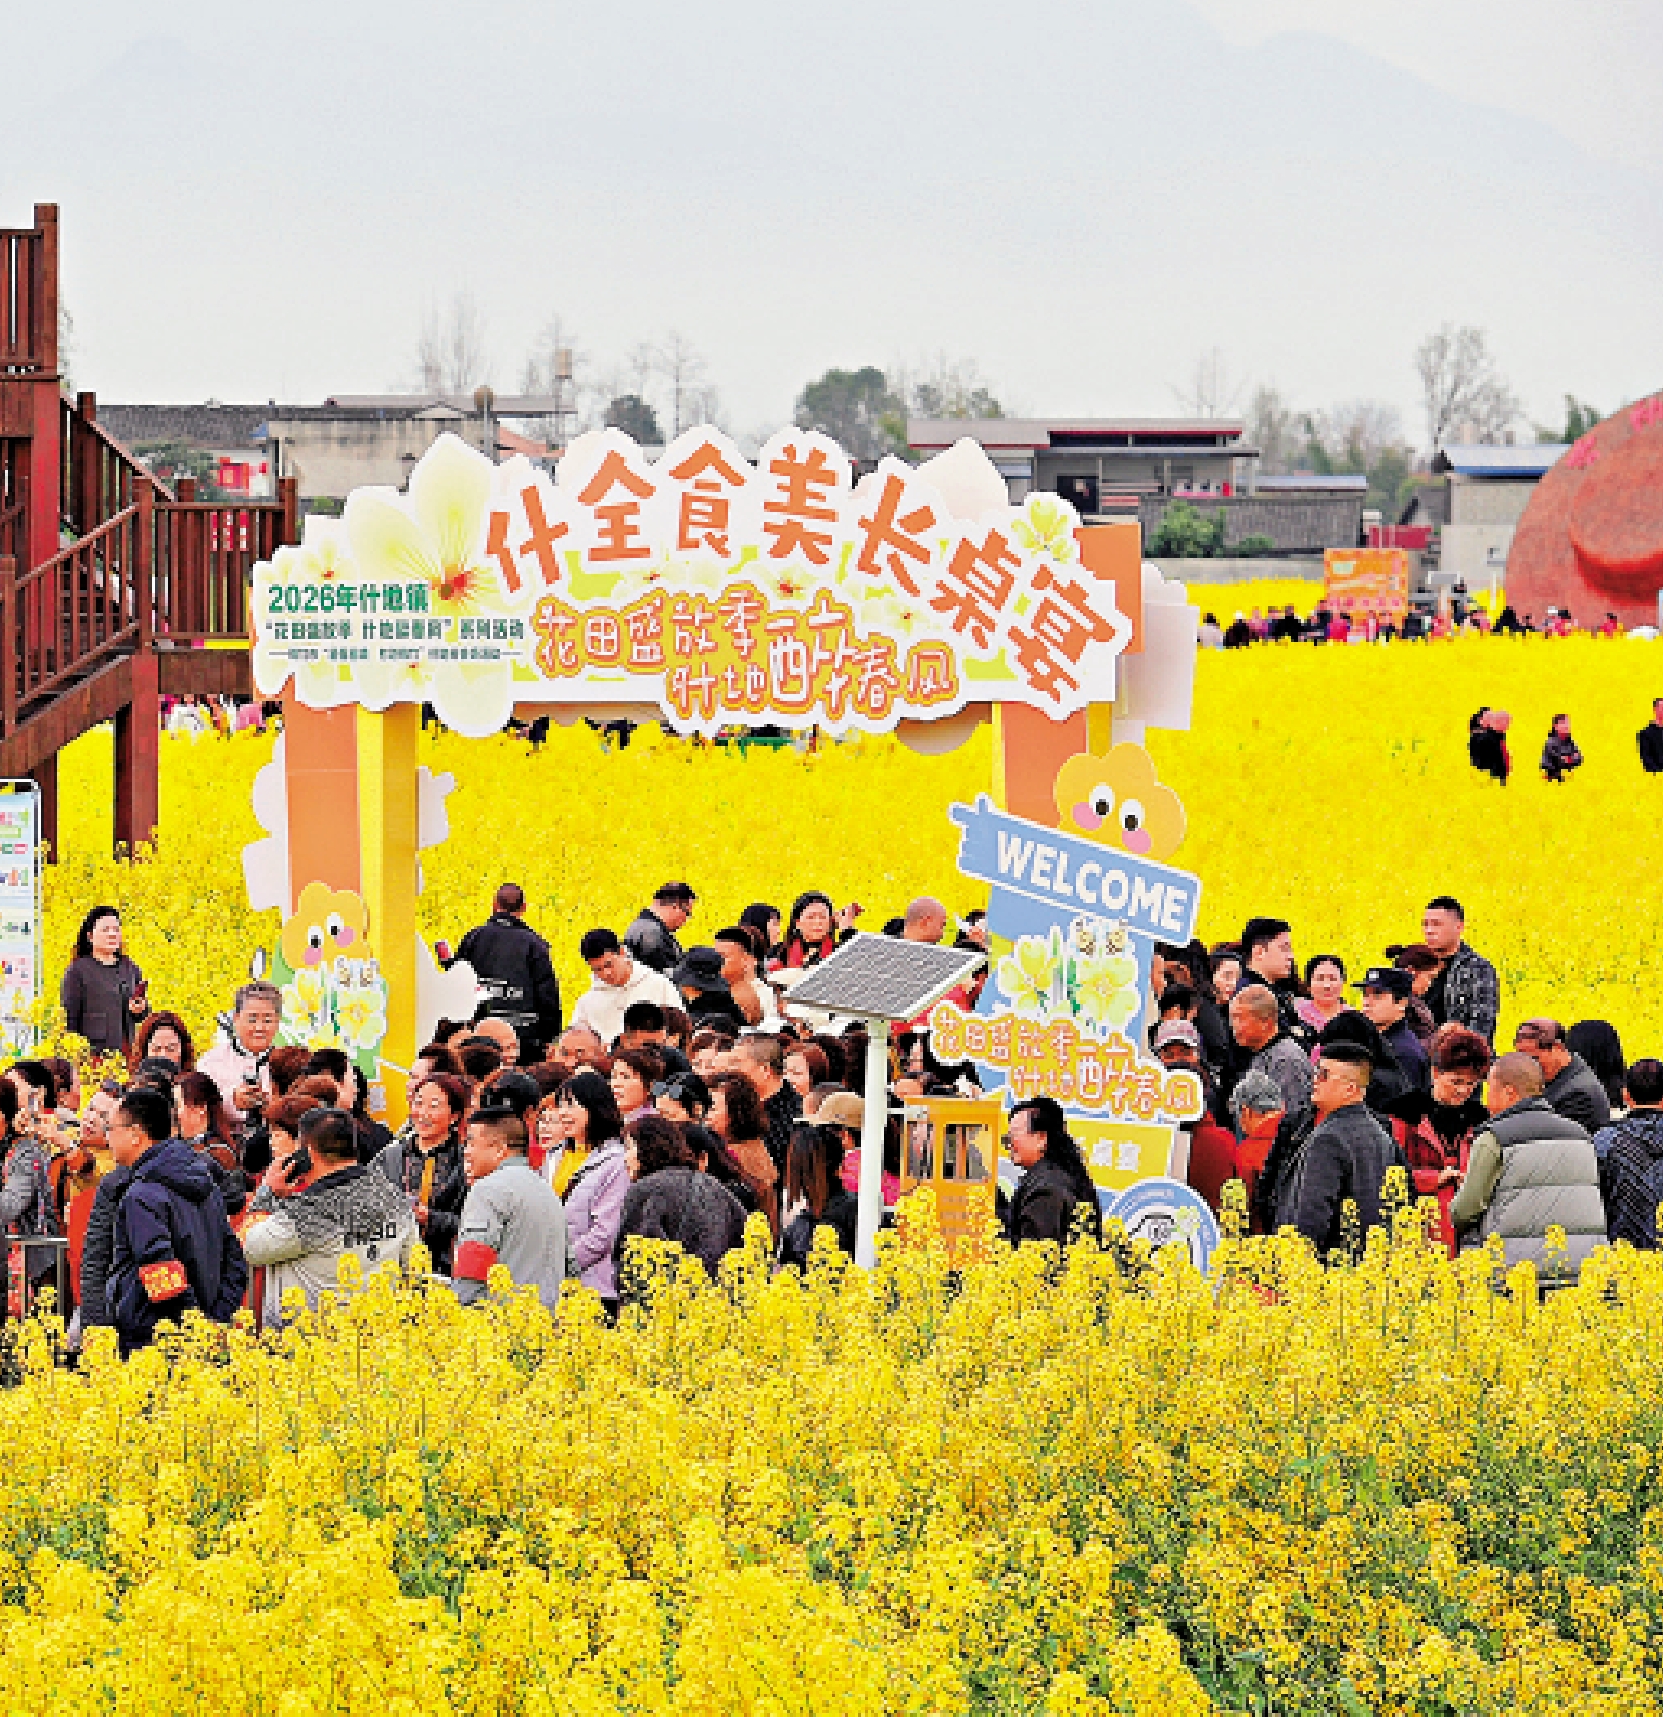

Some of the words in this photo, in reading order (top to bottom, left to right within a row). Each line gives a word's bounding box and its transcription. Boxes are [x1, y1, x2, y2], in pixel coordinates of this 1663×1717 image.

[269, 583, 429, 613] 2026年什地镇
[486, 440, 1116, 703] 什全食美长桌宴
[535, 583, 765, 676] 花田盛放季
[669, 592, 958, 716] 什地醉春风
[997, 830, 1186, 933] WELCOME
[935, 1012, 1075, 1060] 花田盛放季
